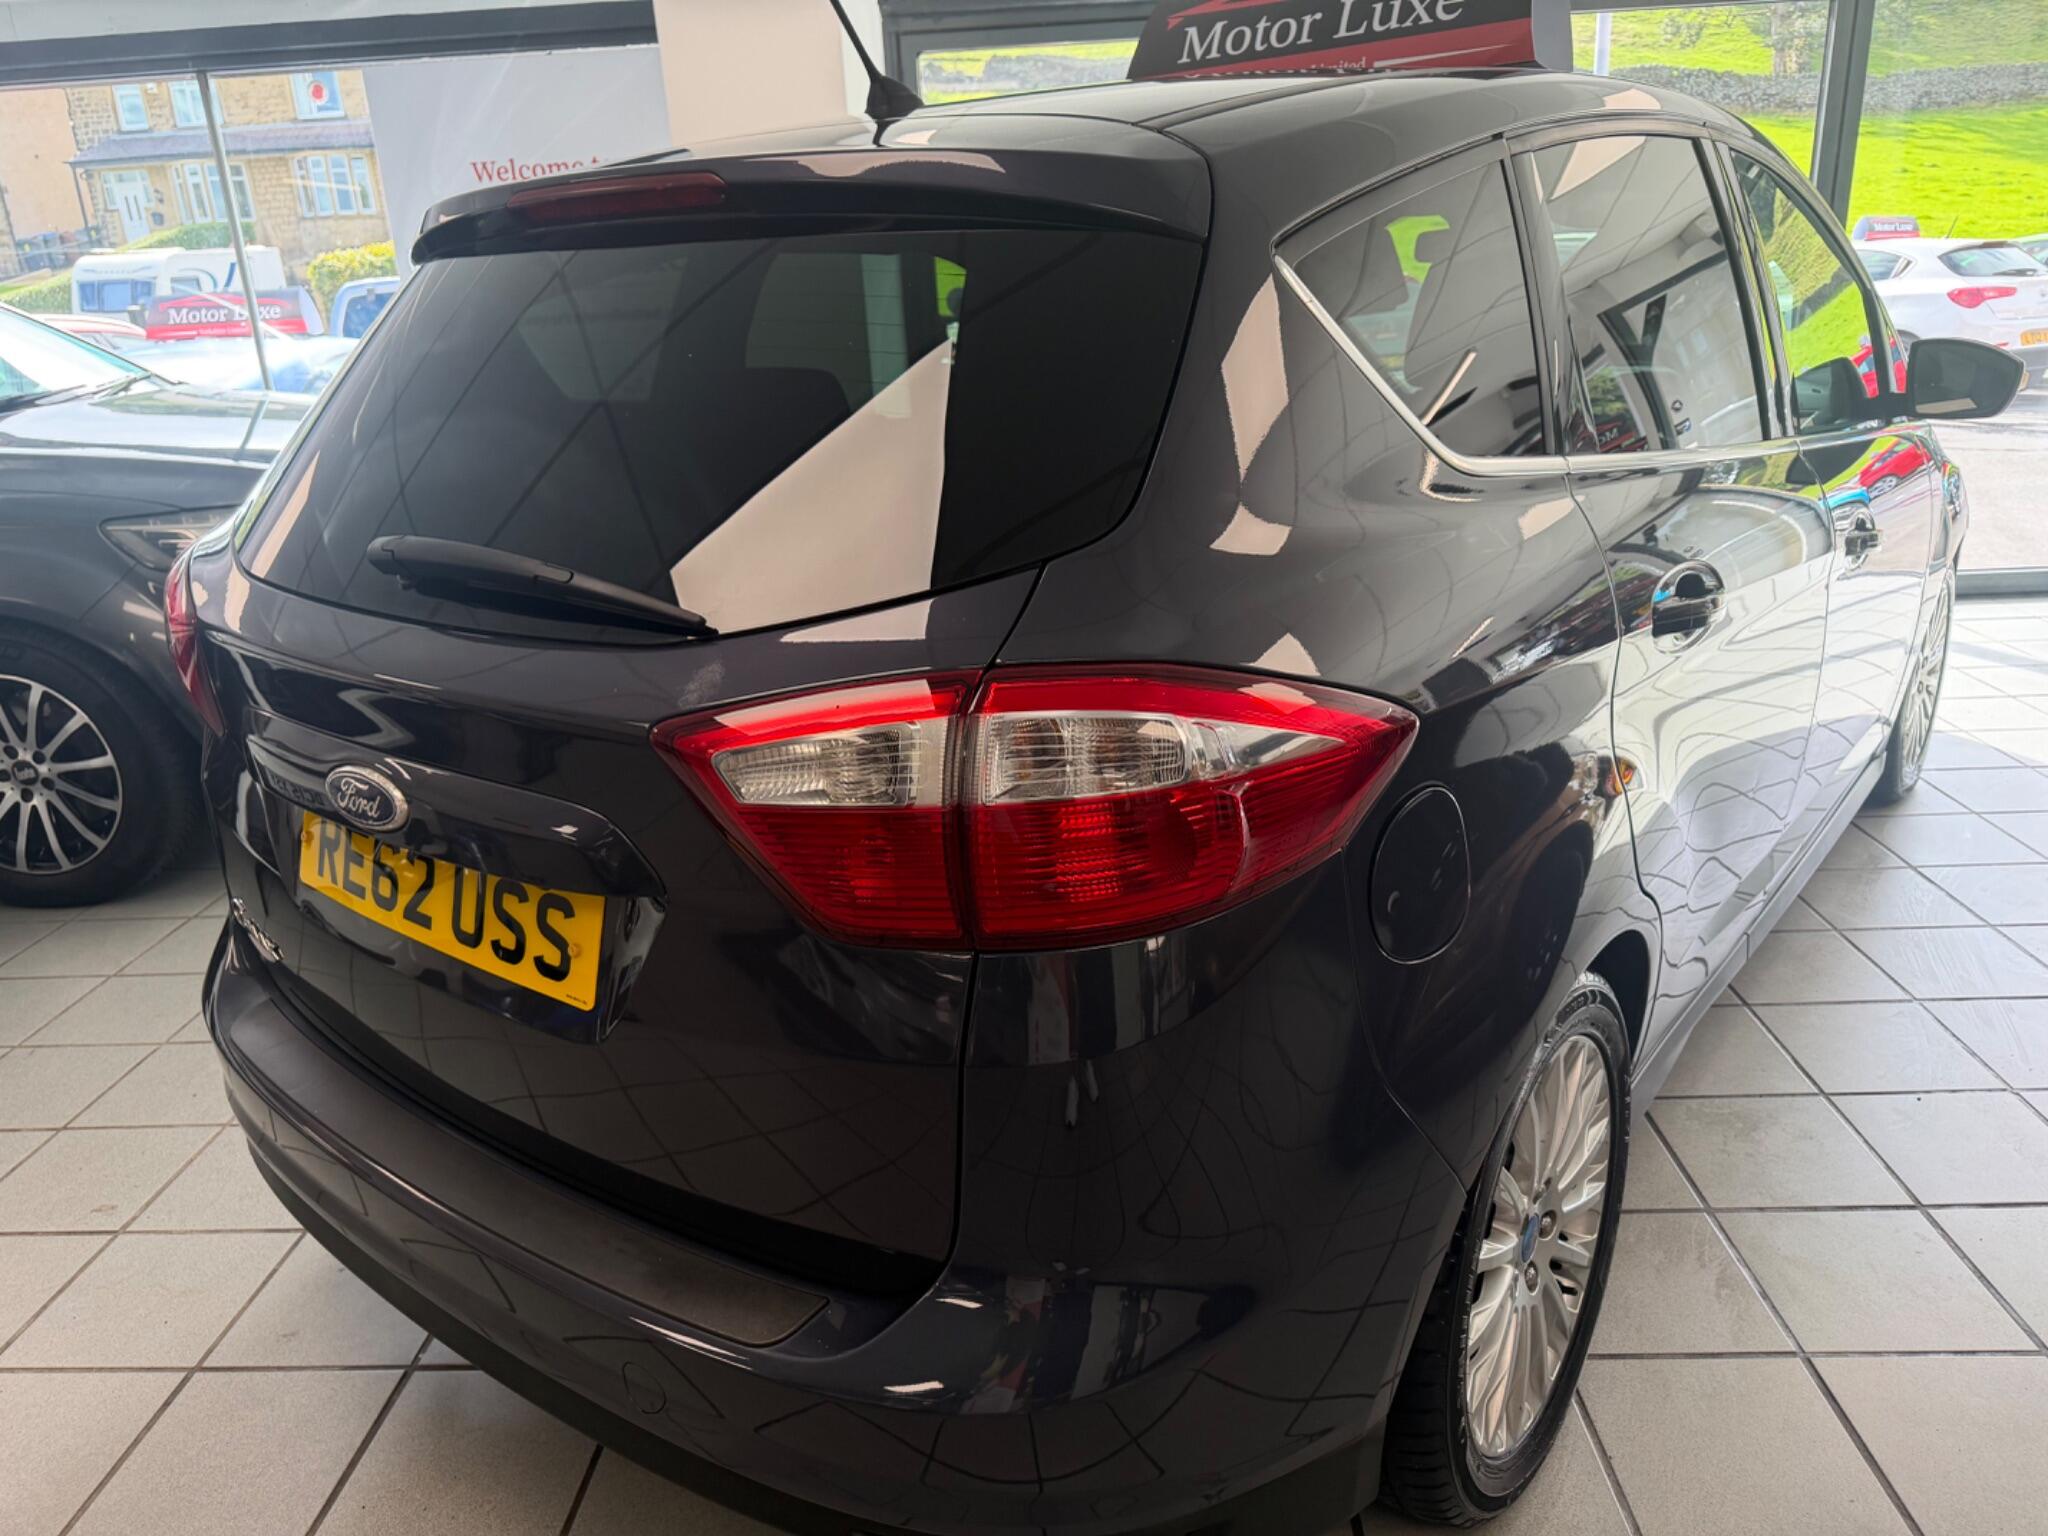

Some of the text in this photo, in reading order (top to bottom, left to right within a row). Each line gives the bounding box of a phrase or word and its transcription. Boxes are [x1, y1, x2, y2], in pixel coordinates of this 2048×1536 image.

[1177, 0, 1465, 65] Motor Luxe
[167, 304, 281, 325] Motor Lxe
[339, 776, 381, 820] Ford
[317, 817, 434, 931] RE62
[451, 866, 576, 982] USS
